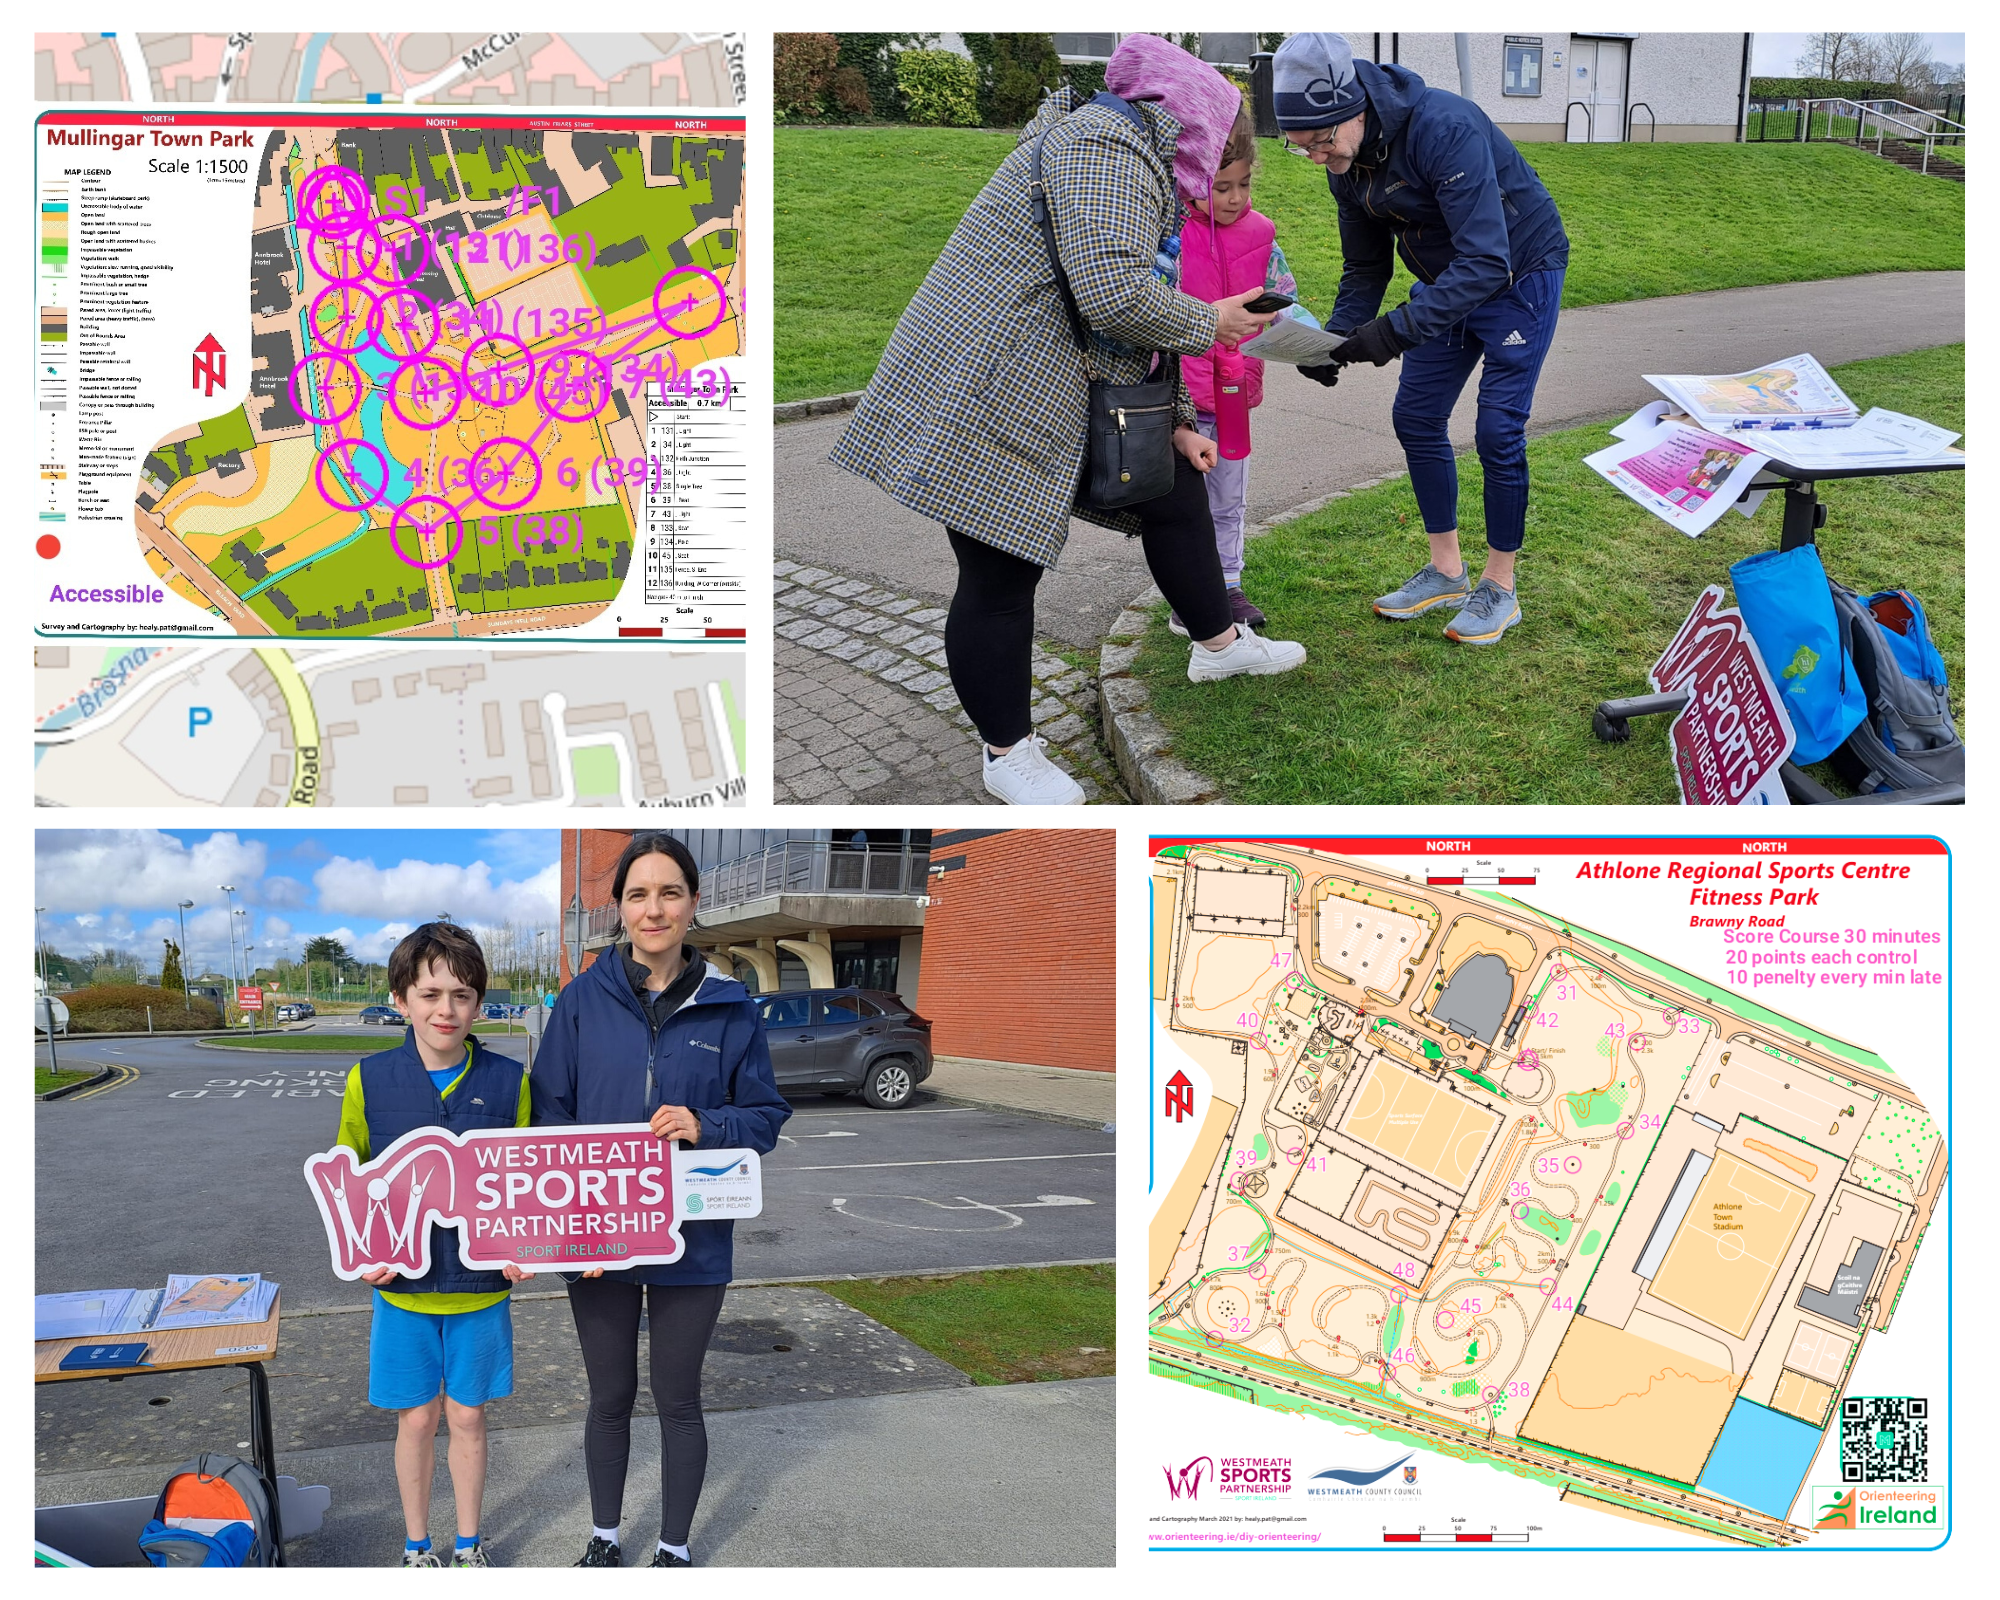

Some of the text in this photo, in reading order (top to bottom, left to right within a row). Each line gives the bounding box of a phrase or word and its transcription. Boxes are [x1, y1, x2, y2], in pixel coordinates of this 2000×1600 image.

[426, 118, 458, 127] NORTH
[675, 120, 707, 129] NORTH
[47, 128, 254, 150] Mullingar Town Park
[149, 158, 248, 174] Scale 1:1500
[384, 185, 427, 216] S1
[1502, 338, 1526, 346] adidas
[557, 458, 579, 488] 6
[478, 514, 584, 554] 5 (38)
[50, 584, 164, 603] Accessible
[77, 647, 149, 718] Brosna
[1728, 650, 1780, 766] WESTMEATH
[1703, 673, 1760, 798] SPORTS
[1686, 702, 1728, 805] PARTNERSHI
[293, 746, 318, 804] Road
[1426, 841, 1471, 851] NORTH
[1742, 842, 1787, 852] NORTH
[1576, 861, 1910, 884] Athlone Regional Sports Centre
[1690, 888, 1820, 906] Fitness Park
[1690, 916, 1786, 929] Brawny Road
[1724, 929, 1941, 944] Score Course 30 minutes
[1270, 954, 1292, 968] 47
[1726, 950, 1917, 968] 20 points each control
[1728, 969, 1942, 987] 10 penelty every min late
[1557, 986, 1576, 1000] 31
[1237, 1014, 1258, 1028] 40
[1537, 1014, 1558, 1027] 42
[1678, 1019, 1700, 1033] 33
[1604, 1024, 1626, 1038] 43
[696, 1040, 721, 1053] Columbi
[1639, 1114, 1661, 1129] 34
[474, 1140, 662, 1169] WESTMEATH
[1236, 1151, 1257, 1166] 39
[1306, 1158, 1327, 1172] 41
[1538, 1158, 1559, 1172] 35
[476, 1167, 665, 1210] SPORTS
[1510, 1182, 1530, 1197] 36
[1713, 1203, 1742, 1211] Athlone
[1713, 1213, 1733, 1221] Town
[476, 1212, 666, 1238] PARTNERSHIP
[1713, 1222, 1744, 1230] Stadium
[516, 1243, 628, 1258] SPORT IRELAND
[1228, 1246, 1249, 1261] 37
[1394, 1264, 1415, 1277] 48
[1460, 1300, 1482, 1313] 45
[1552, 1297, 1573, 1311] 44
[1229, 1318, 1251, 1333] 32
[1393, 1349, 1415, 1363] 46
[1508, 1382, 1530, 1397] 38
[1220, 1458, 1291, 1467] WESTMEATH
[1220, 1468, 1291, 1483] SPORTS
[1220, 1485, 1291, 1493] PARTNERSHIP
[1860, 1491, 1936, 1503] Orienteering
[1860, 1506, 1936, 1524] Ireland
